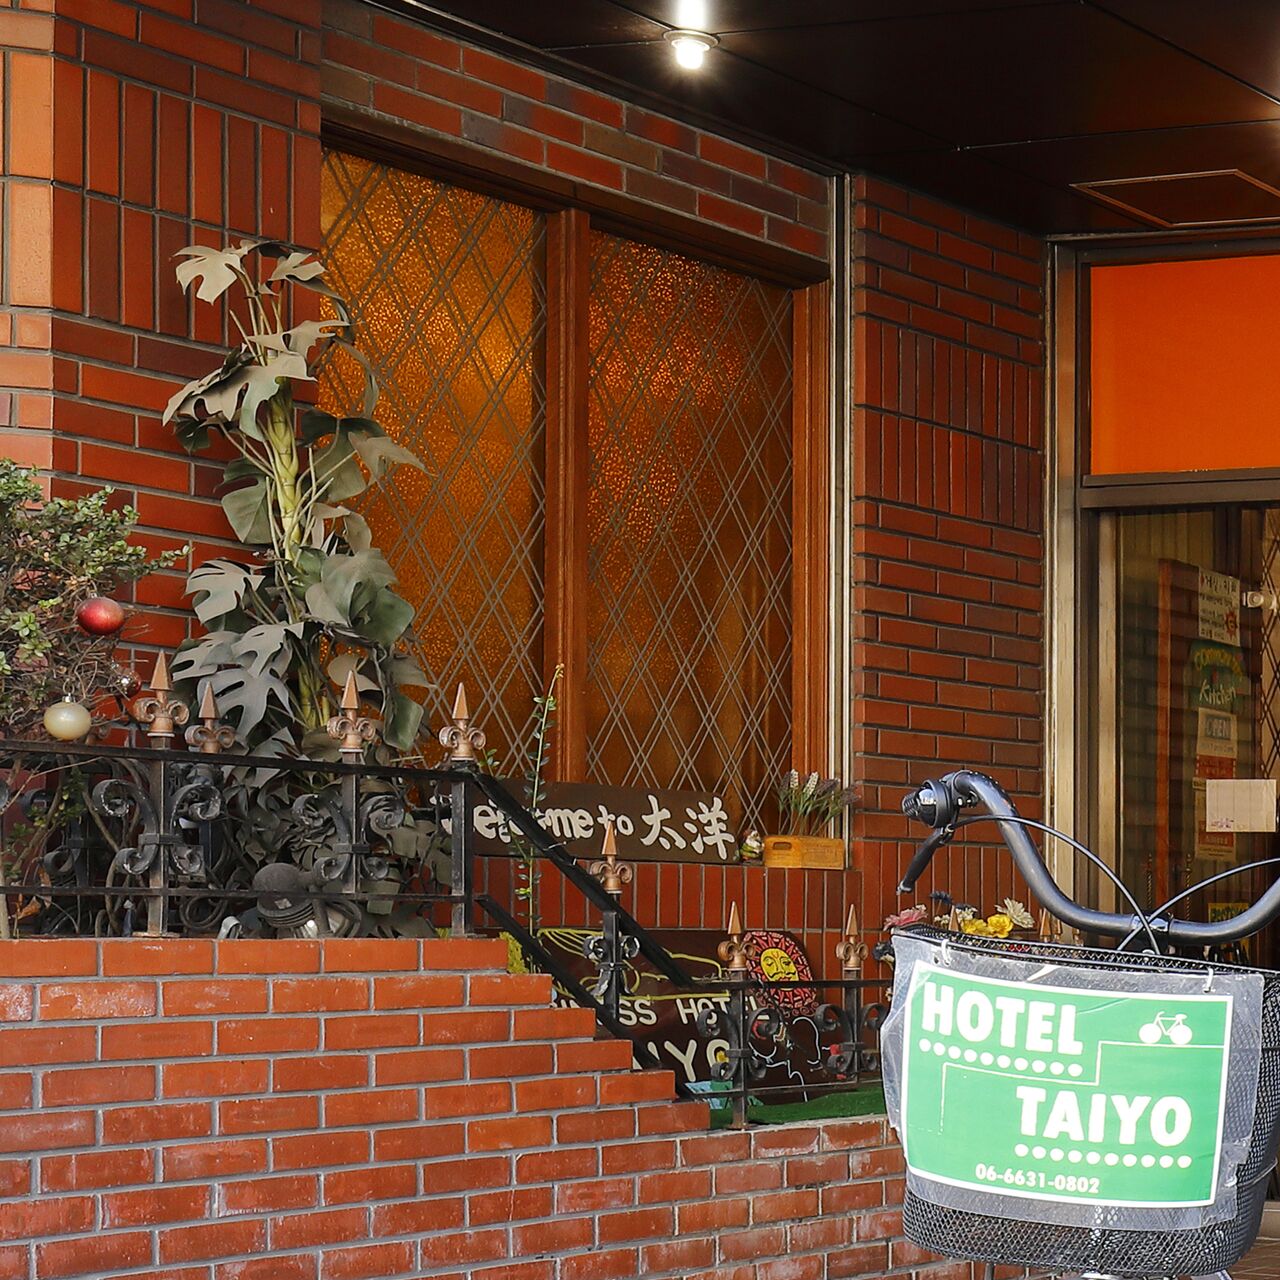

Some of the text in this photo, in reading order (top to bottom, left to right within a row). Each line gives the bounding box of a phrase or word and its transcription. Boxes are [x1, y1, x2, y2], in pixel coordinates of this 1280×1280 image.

[640, 794, 736, 861] 太洋
[921, 981, 1084, 1056] HOTEL
[1015, 1085, 1192, 1147] TAIYO
[975, 1162, 1100, 1195] 06-6631-0802
